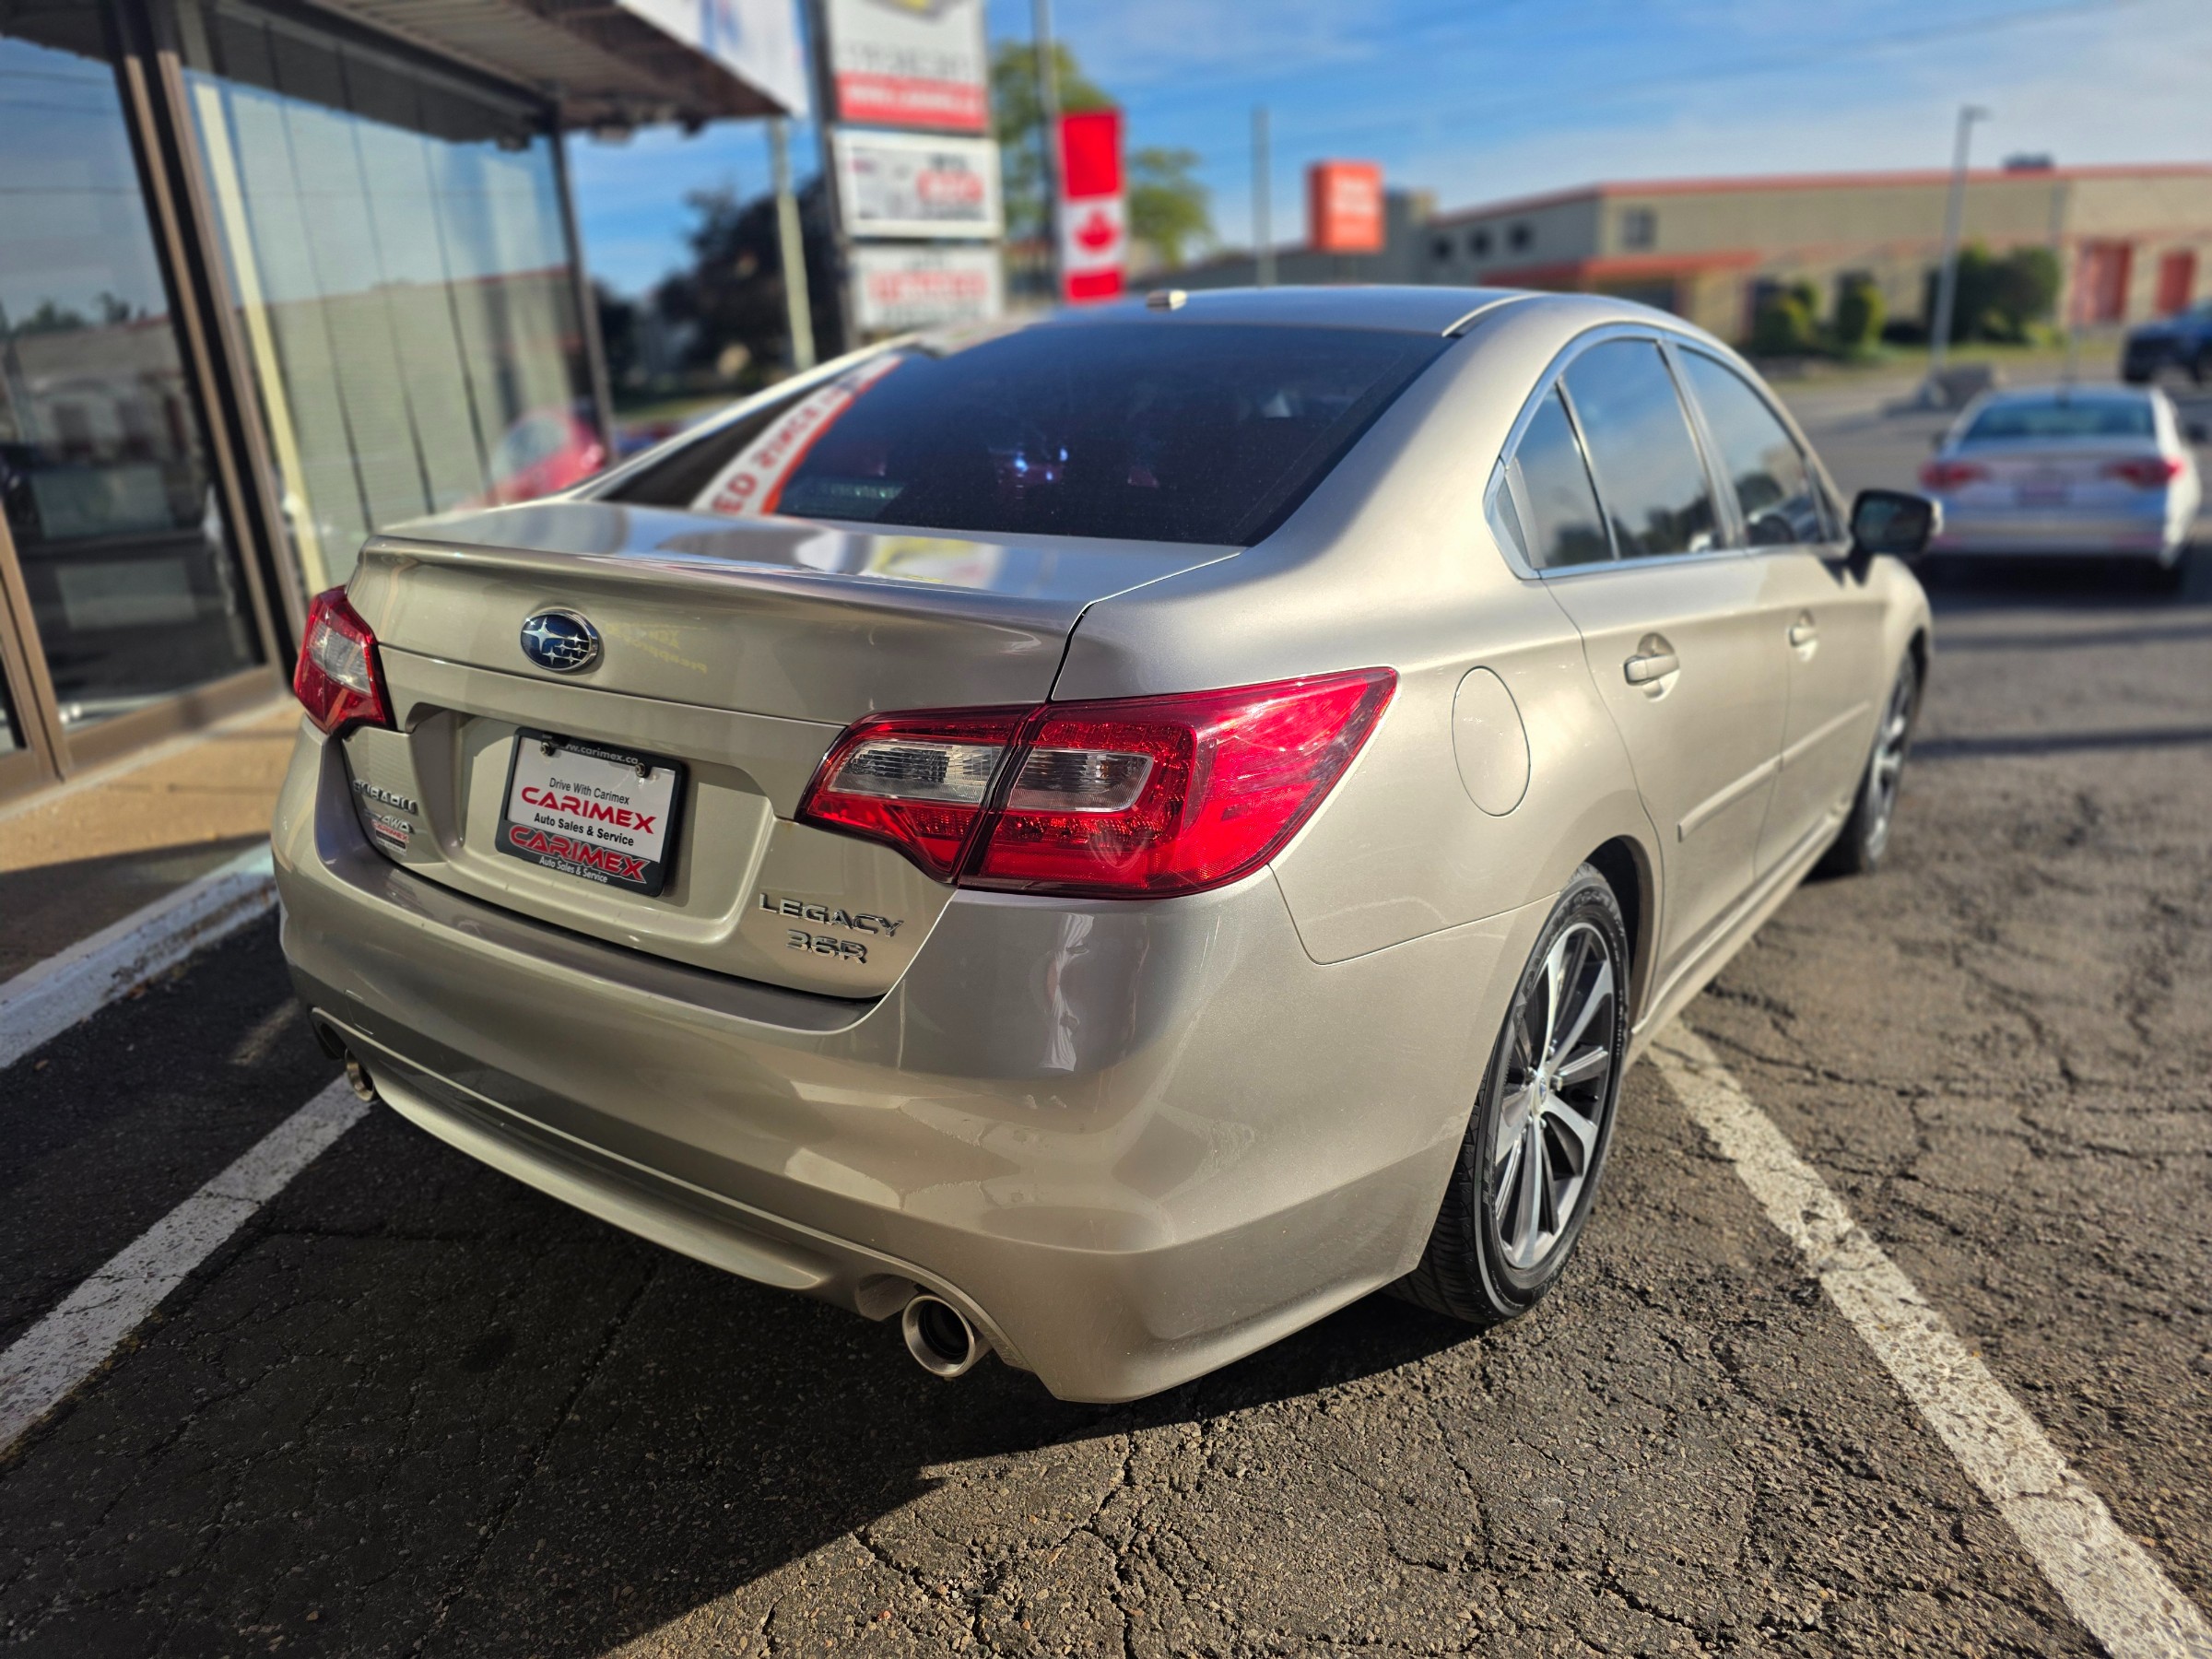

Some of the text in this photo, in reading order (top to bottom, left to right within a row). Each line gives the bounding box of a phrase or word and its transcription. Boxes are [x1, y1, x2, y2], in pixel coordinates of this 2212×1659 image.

[353, 779, 418, 817] SUBARU
[549, 777, 630, 806] Drive With Carimex
[521, 786, 657, 835] CARIMEX
[534, 812, 634, 847] Auto Sales & Service
[509, 825, 650, 884] CARIMEX
[539, 855, 608, 884] Auto Sales & Service
[759, 892, 905, 938] LEGACY
[785, 928, 867, 965] 3.6R
